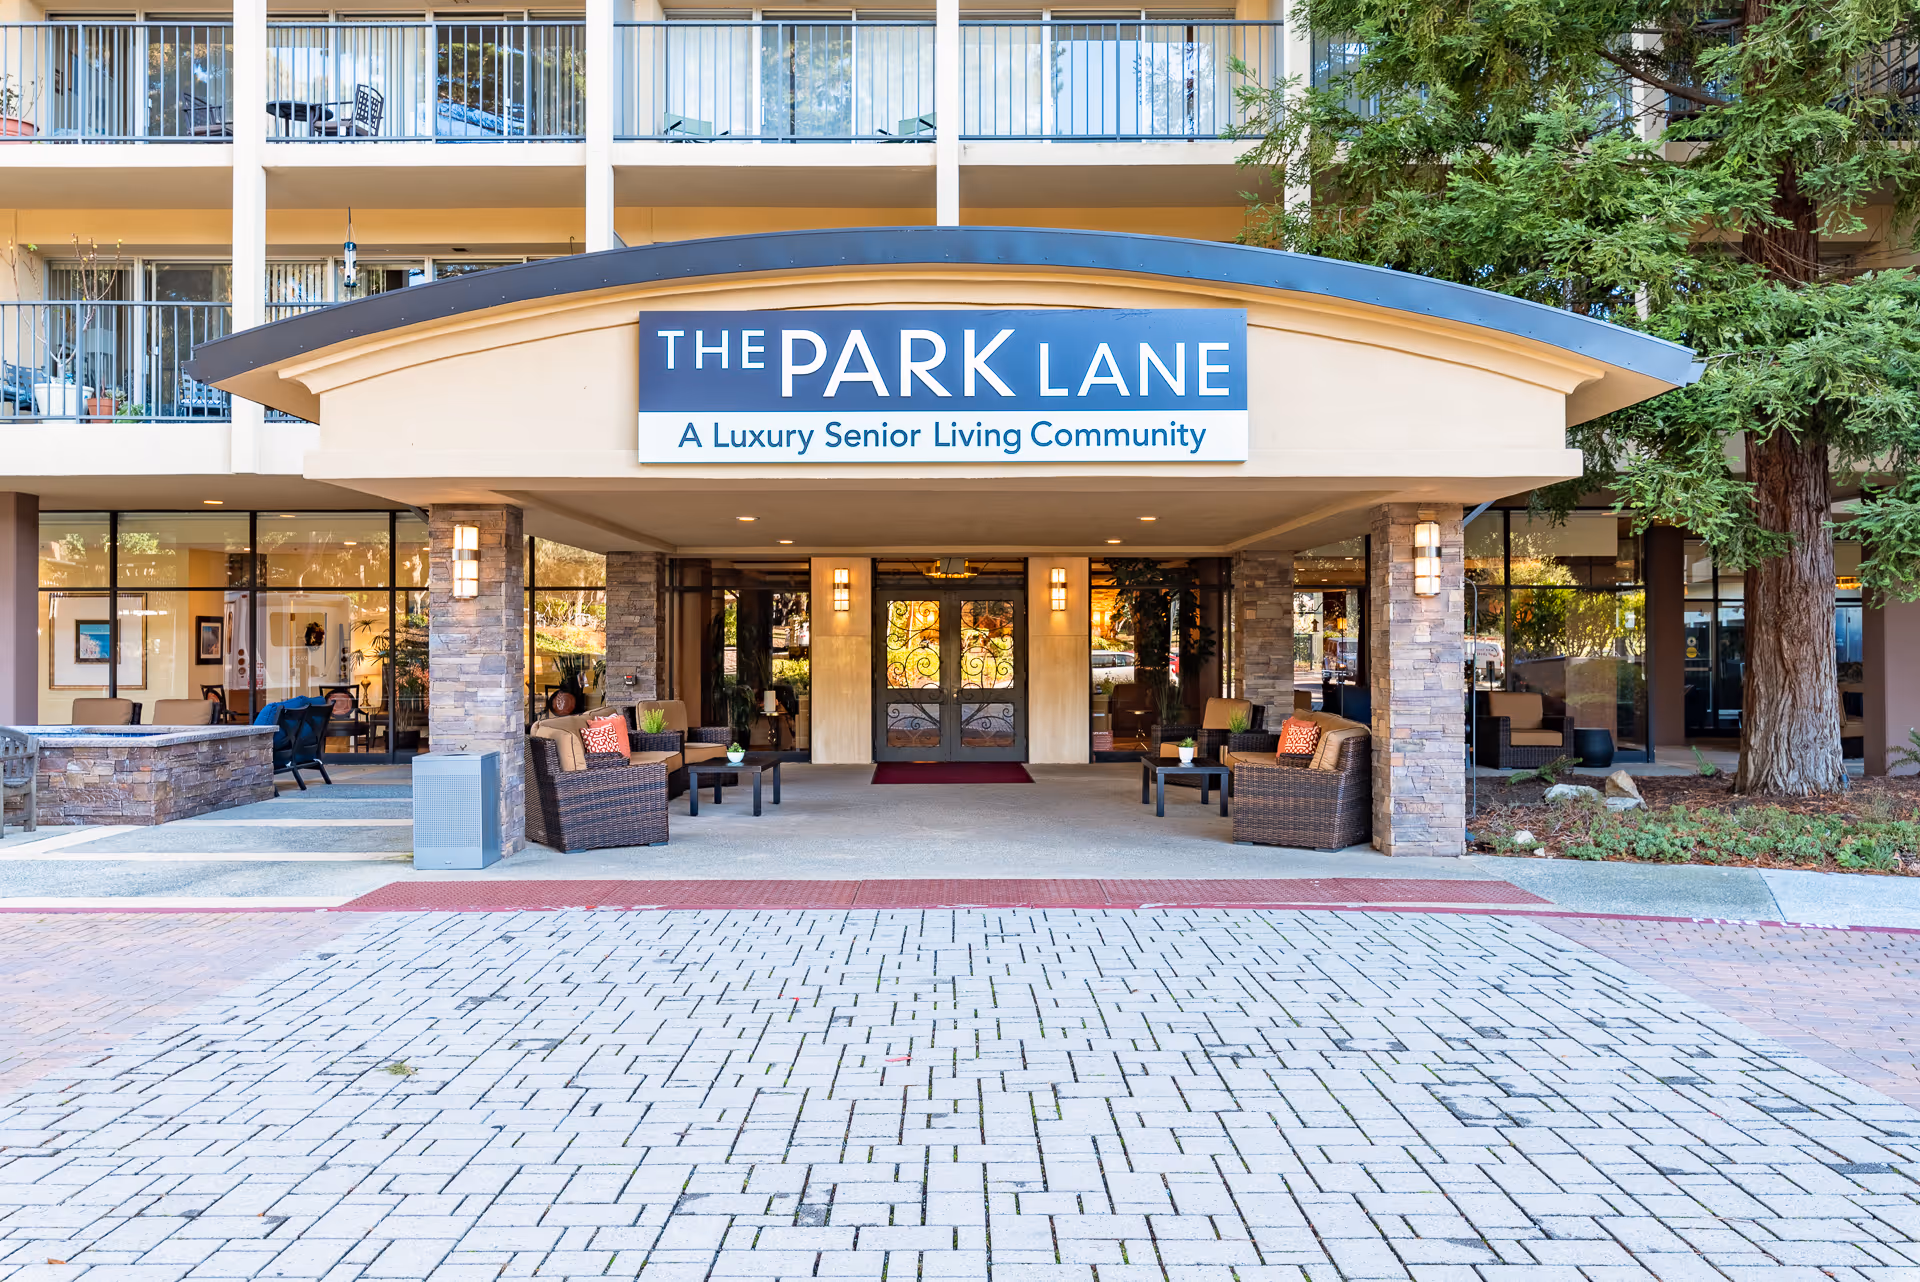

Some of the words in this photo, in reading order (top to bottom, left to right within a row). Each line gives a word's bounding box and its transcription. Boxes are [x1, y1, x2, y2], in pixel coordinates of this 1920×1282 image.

[657, 329, 766, 370] THE
[781, 328, 1017, 398] PARK
[1039, 341, 1230, 397] LANE
[677, 422, 703, 448] A
[714, 422, 815, 456] Luxury
[825, 421, 922, 448] Senior
[934, 421, 1021, 455] Living
[1030, 420, 1207, 454] Community
